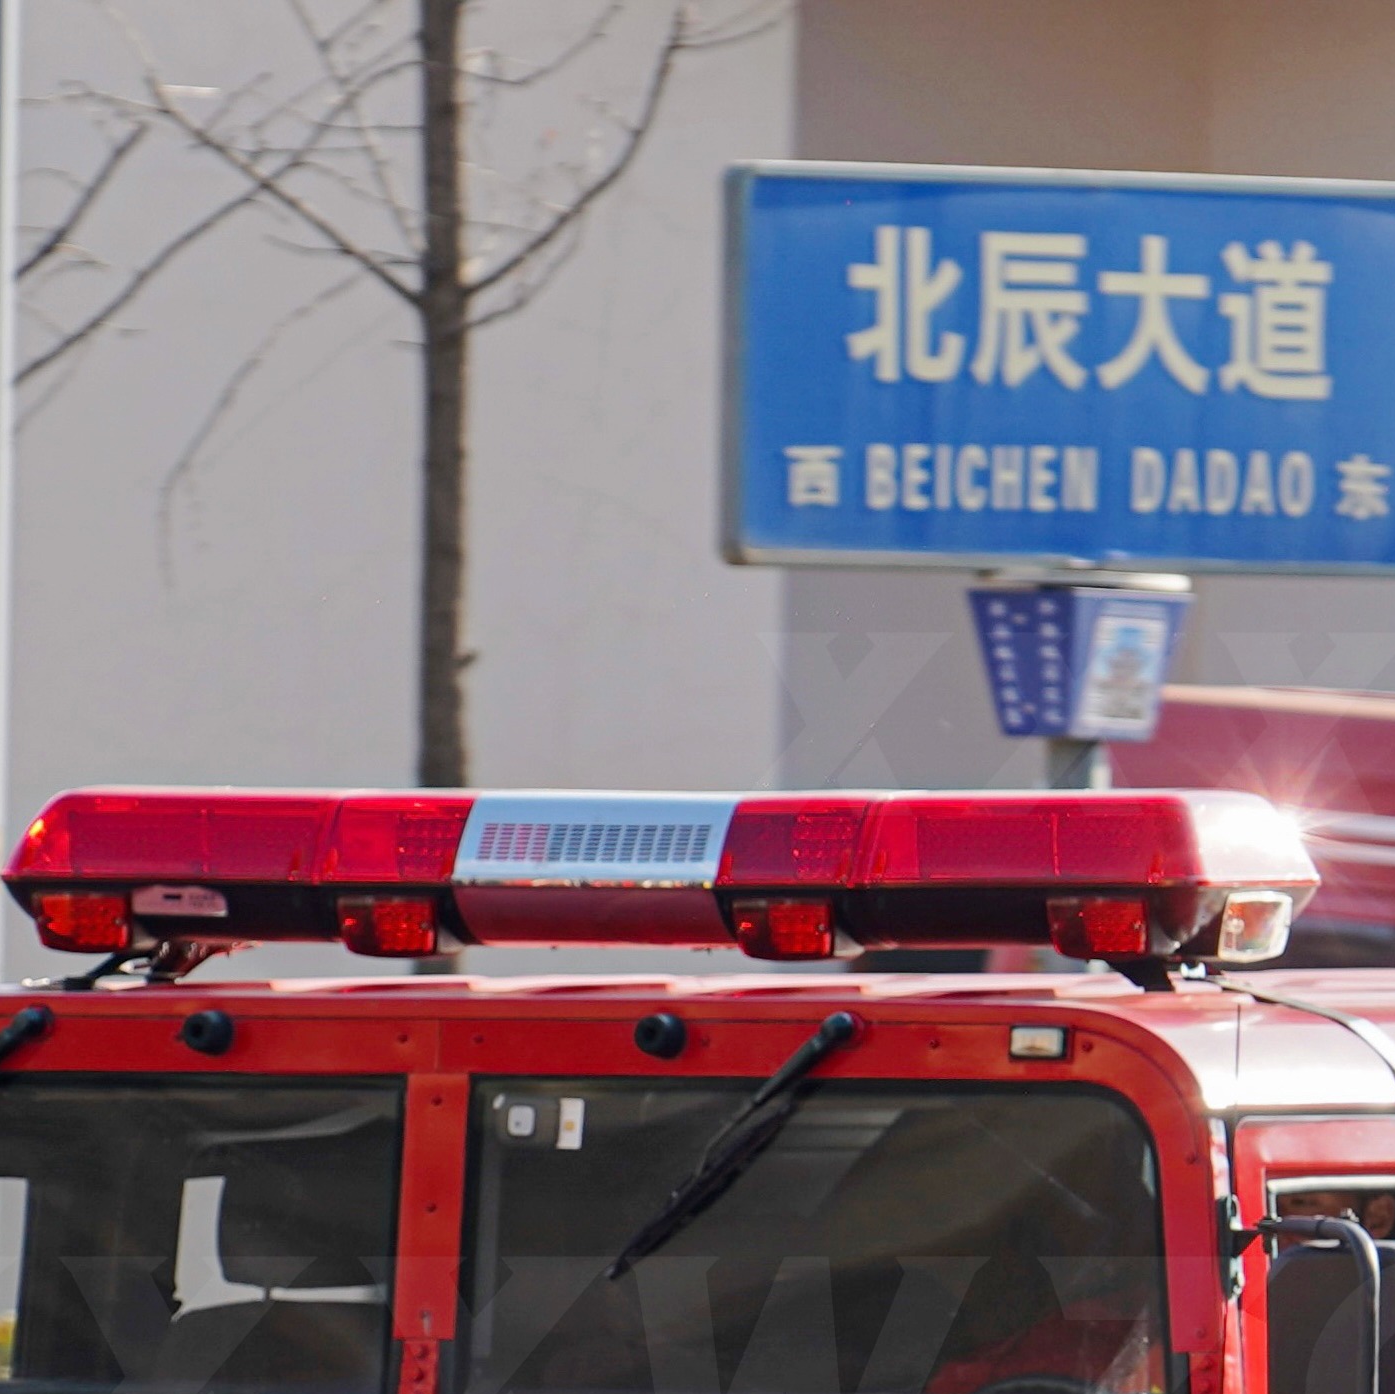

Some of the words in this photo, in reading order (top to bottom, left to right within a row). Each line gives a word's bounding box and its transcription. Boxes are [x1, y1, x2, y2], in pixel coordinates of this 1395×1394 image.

[846, 224, 1334, 401] 北辰大道
[784, 445, 843, 507] 西
[864, 442, 1100, 512] BEICHEN
[1130, 447, 1316, 515] DADAO
[1335, 455, 1393, 521] 东
